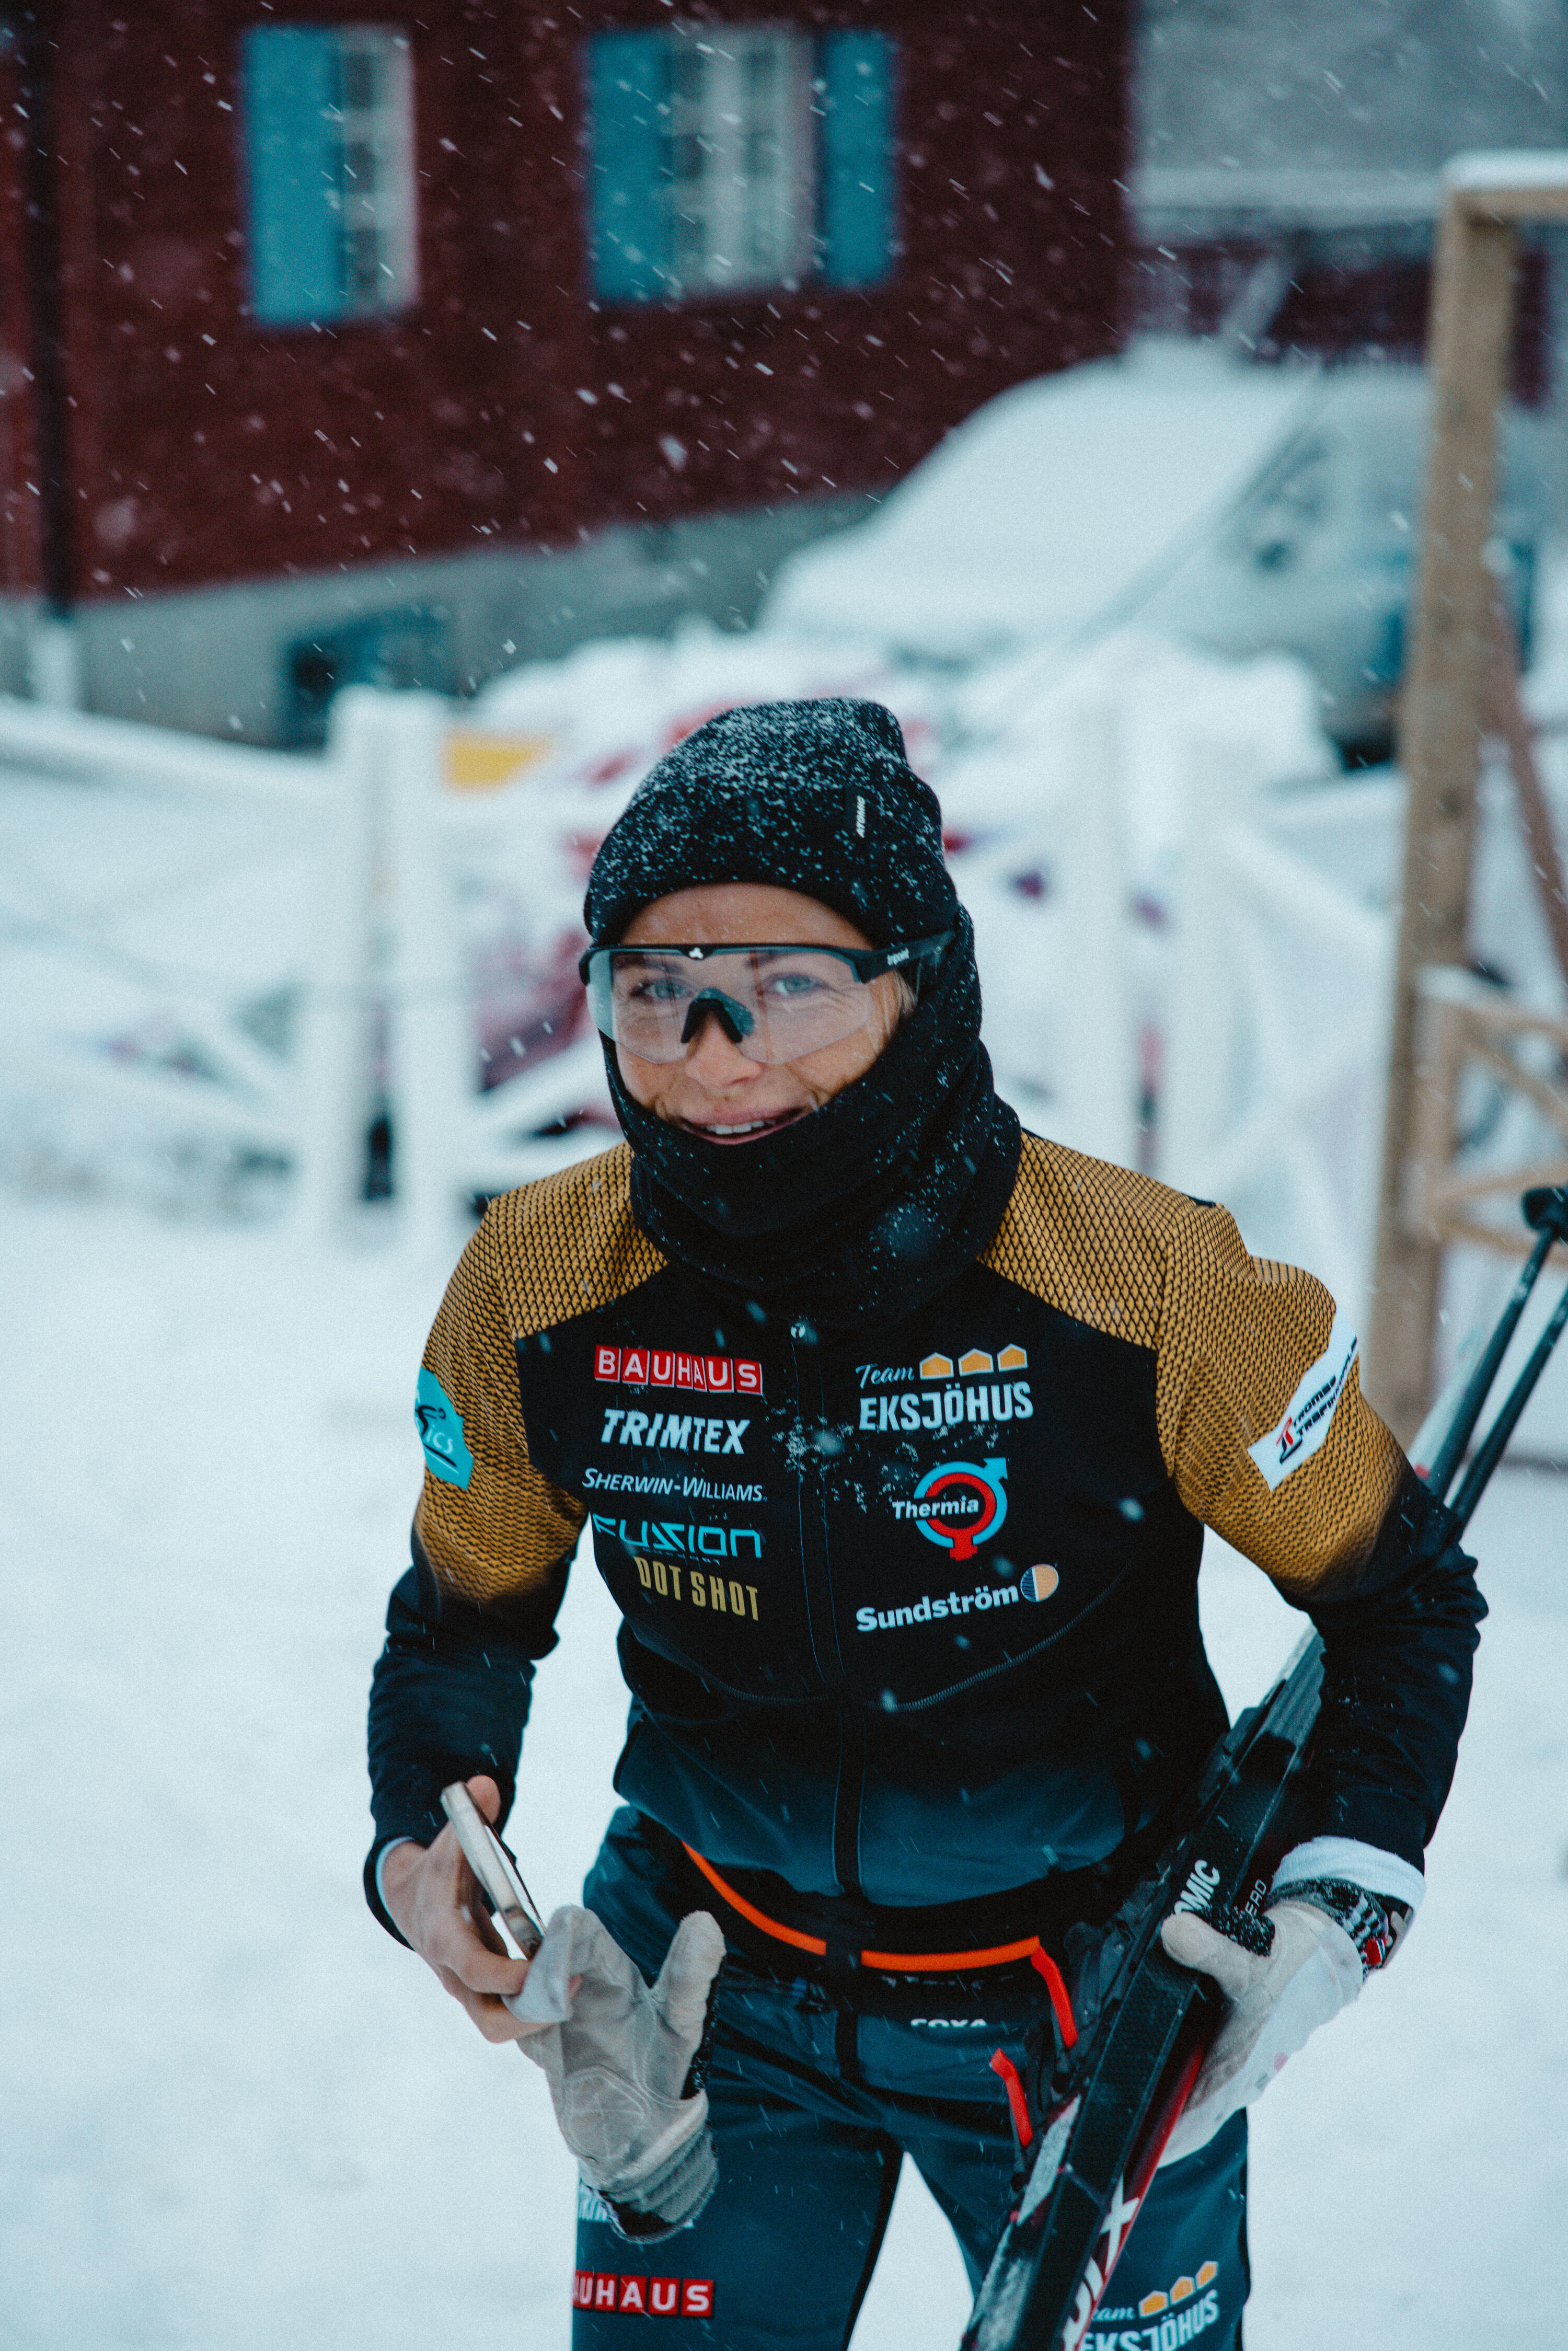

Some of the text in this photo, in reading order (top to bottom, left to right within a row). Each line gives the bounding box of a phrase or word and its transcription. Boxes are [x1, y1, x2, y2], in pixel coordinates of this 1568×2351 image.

[597, 1347, 758, 1389] BAUHAUS
[855, 1363, 915, 1389] Team
[858, 1380, 1033, 1431] EKSJÖHUS
[601, 1408, 750, 1454] TRIMTEX
[892, 1495, 979, 1519] Thermia
[633, 1555, 759, 1621] DOT SHOT
[856, 1585, 1019, 1632] Sundström
[573, 2274, 710, 2312] UHAUS
